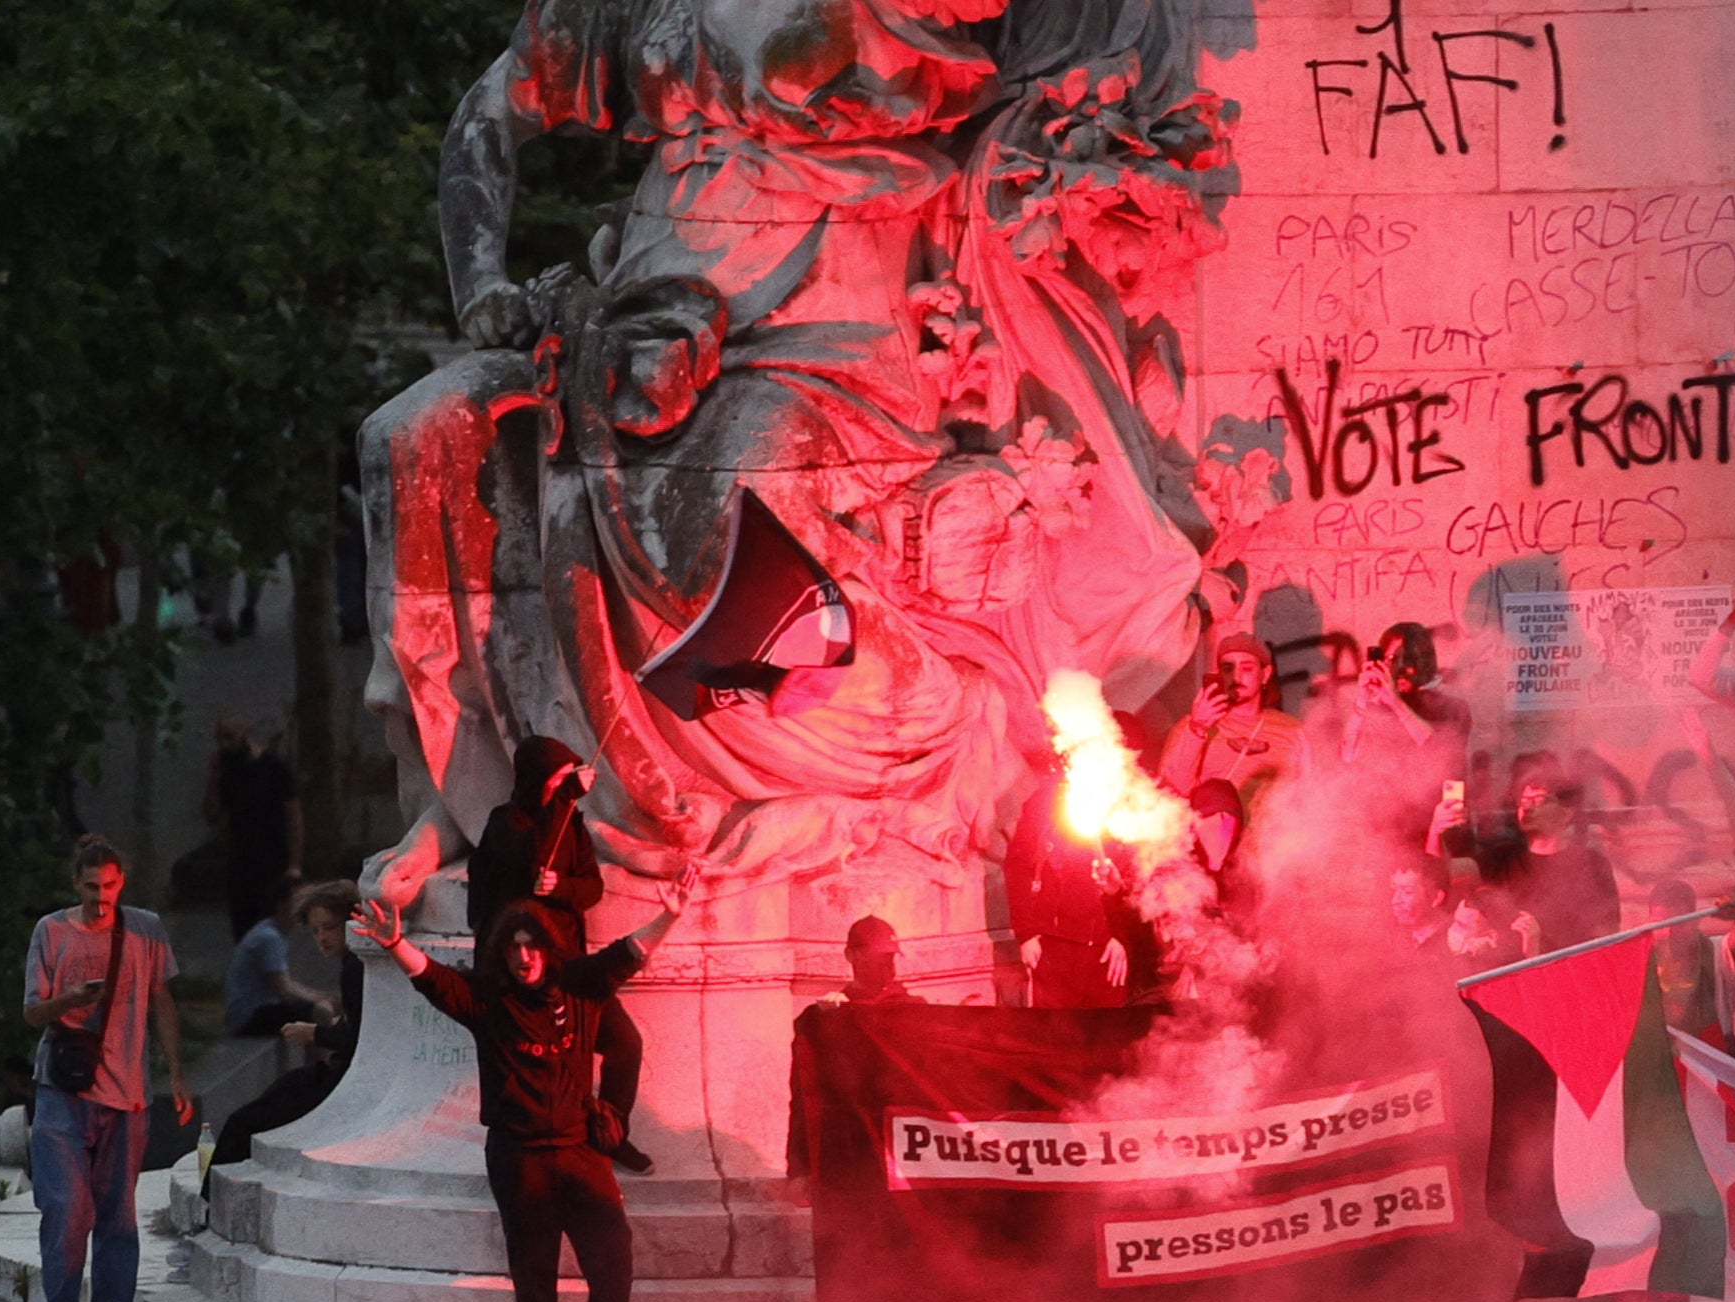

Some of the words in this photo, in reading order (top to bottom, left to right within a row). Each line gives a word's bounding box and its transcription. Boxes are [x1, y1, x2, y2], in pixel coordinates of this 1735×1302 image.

[1276, 359, 1465, 501] VOTE
[1507, 644, 1583, 661] NOUVEAU
[1660, 640, 1706, 656] NOUV
[1517, 662, 1571, 678] FRONT
[1506, 677, 1581, 693] POPULAIRE
[901, 1123, 1089, 1177] Puisque
[1098, 1129, 1142, 1167] le
[1151, 1118, 1289, 1166] temps
[1301, 1083, 1434, 1153] presse
[1114, 1208, 1311, 1275] pressons
[1321, 1196, 1362, 1235] le
[1372, 1181, 1447, 1232] pas
